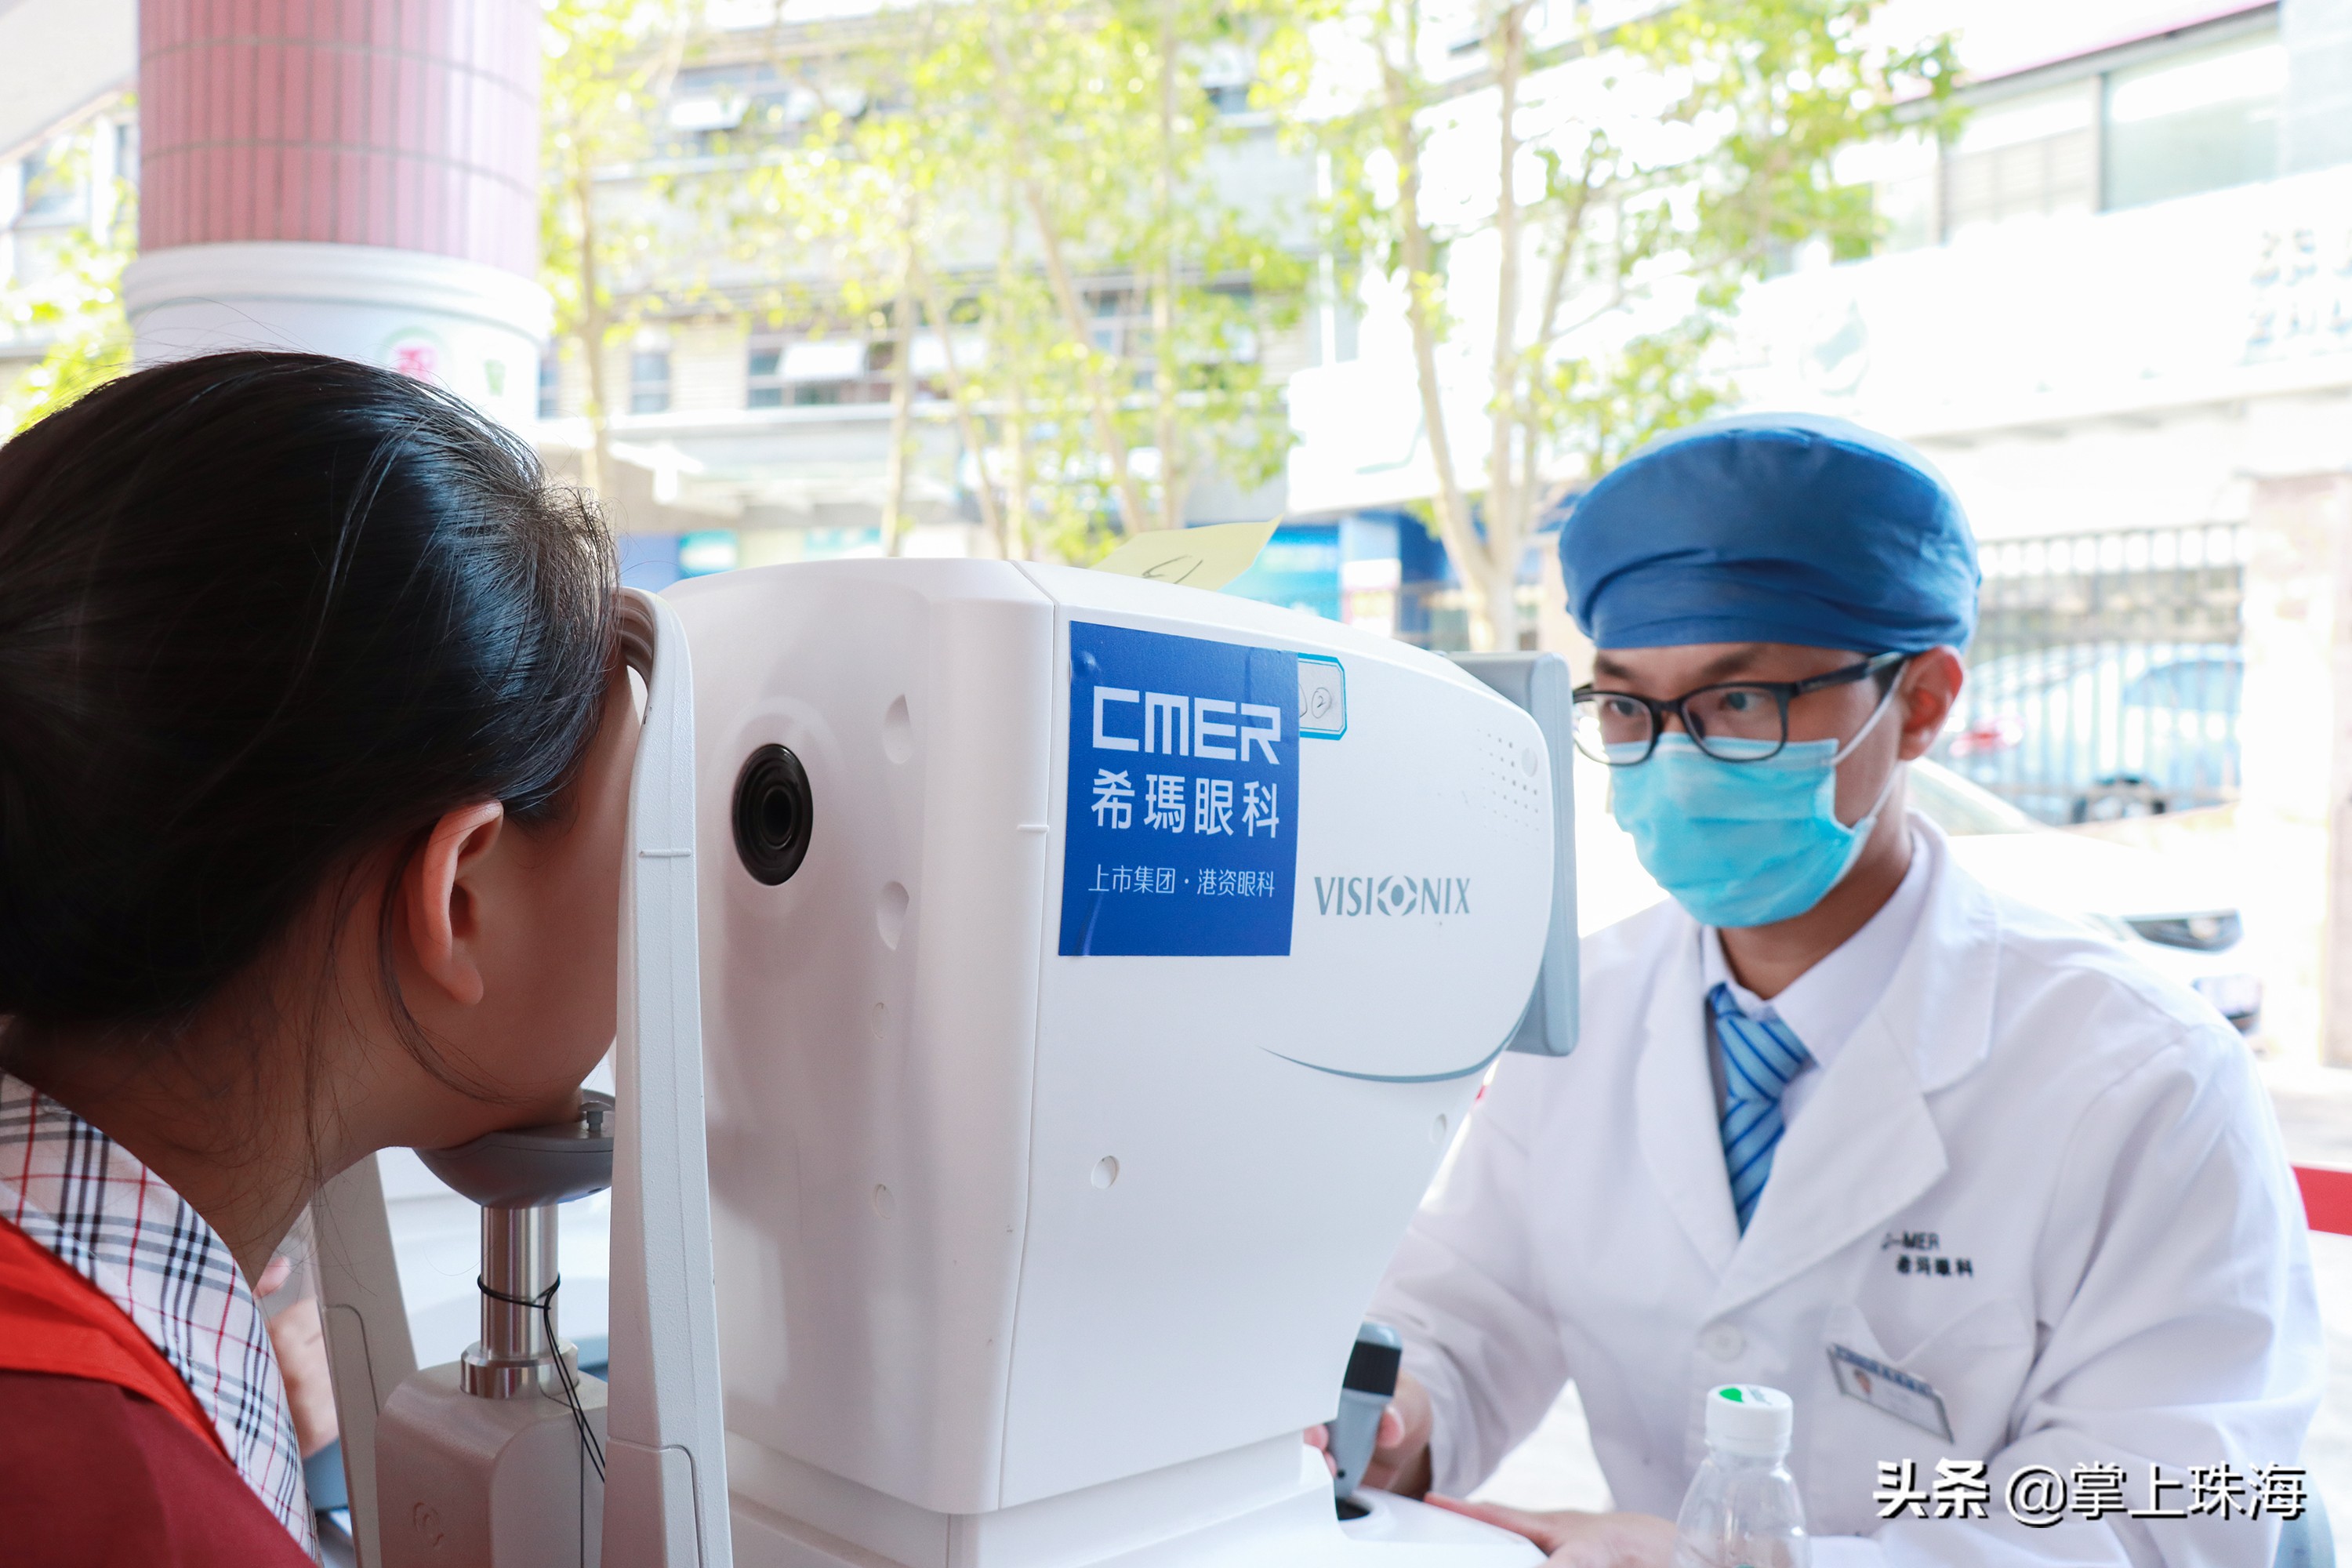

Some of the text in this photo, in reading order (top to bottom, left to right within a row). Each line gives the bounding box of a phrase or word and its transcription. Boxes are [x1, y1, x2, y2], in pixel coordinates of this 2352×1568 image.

[1093, 686, 1281, 764] CMER
[1091, 768, 1280, 839] 希瑪眼科
[1315, 875, 1471, 916] VISIONIX
